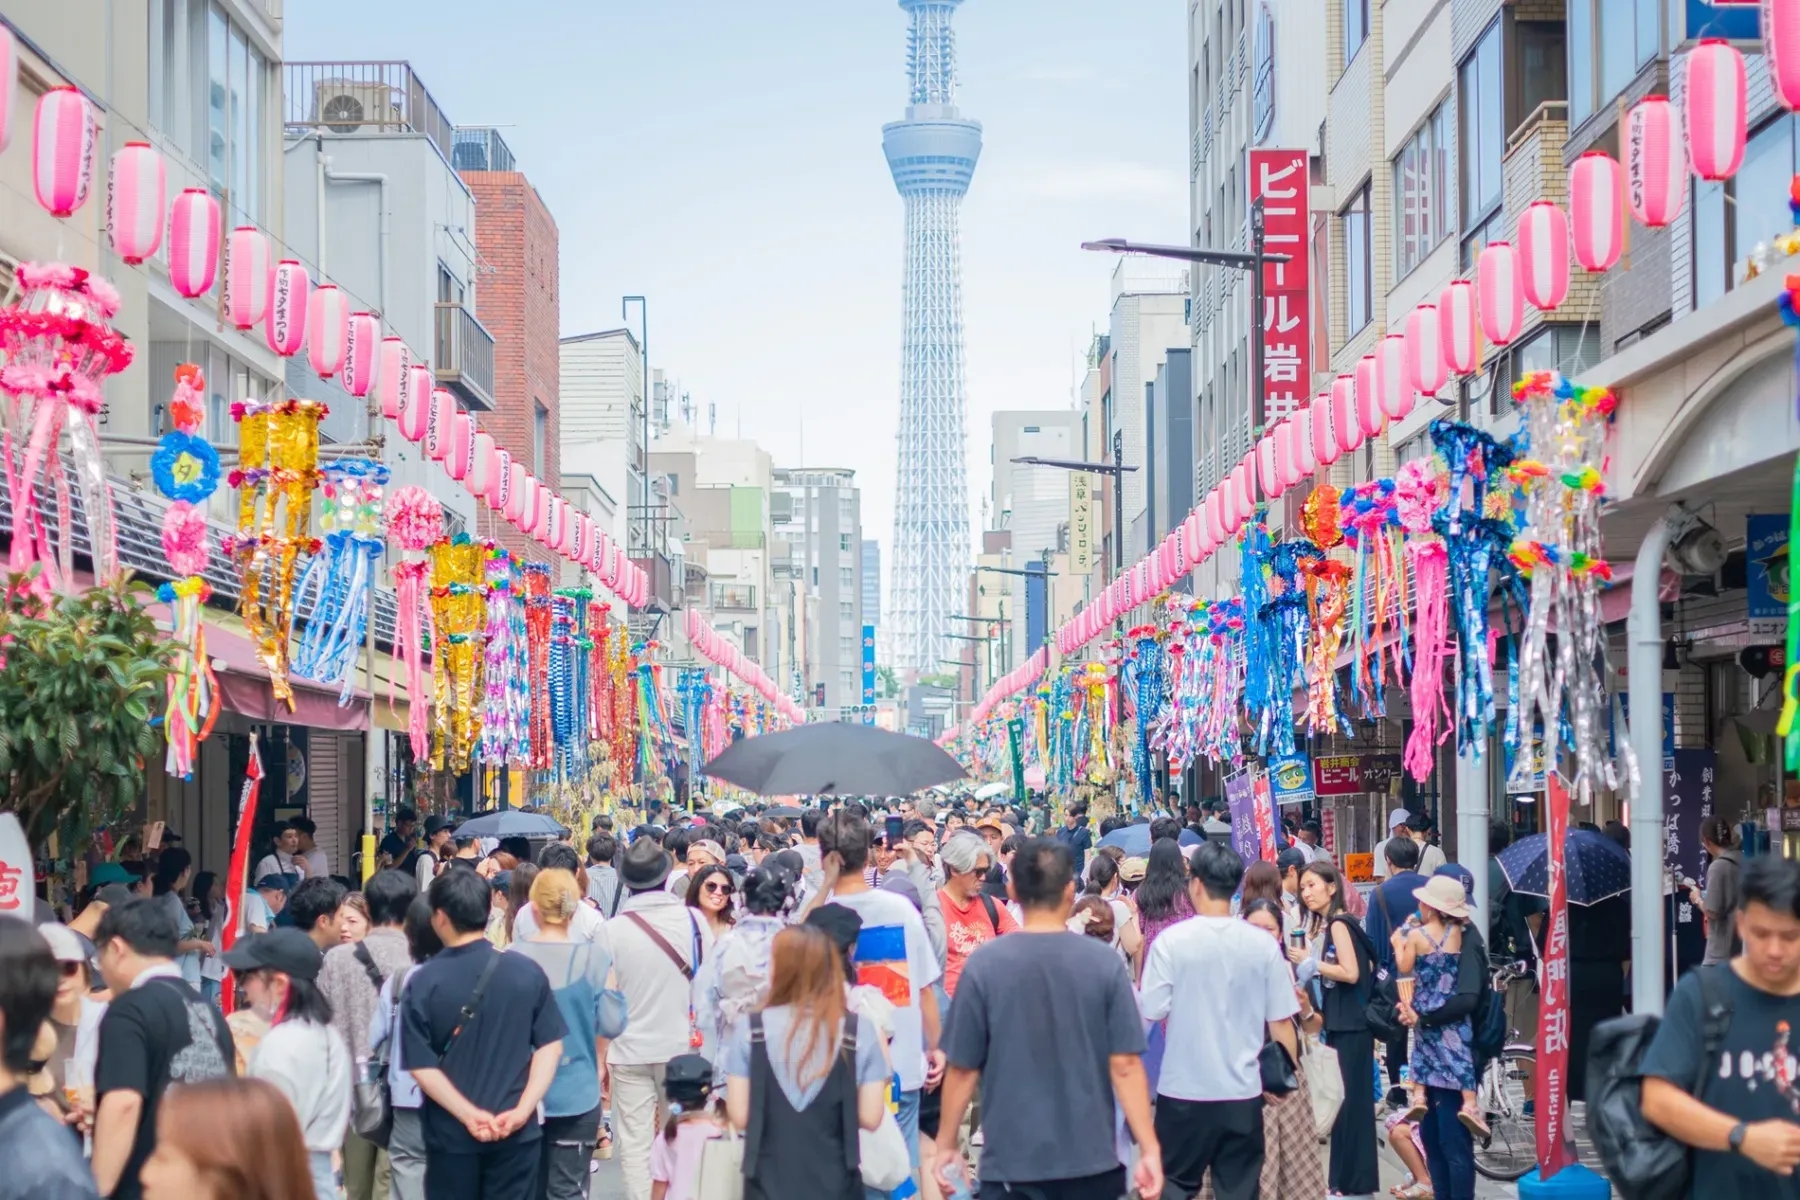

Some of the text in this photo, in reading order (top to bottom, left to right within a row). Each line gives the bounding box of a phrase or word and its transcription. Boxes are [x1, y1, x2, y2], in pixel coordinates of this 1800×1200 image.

[1630, 111, 1643, 209] 下町七夕まつり
[276, 268, 290, 343] 下町七夕まつり
[1321, 767, 1359, 784] ビニール
[1364, 768, 1401, 780] オンリー
